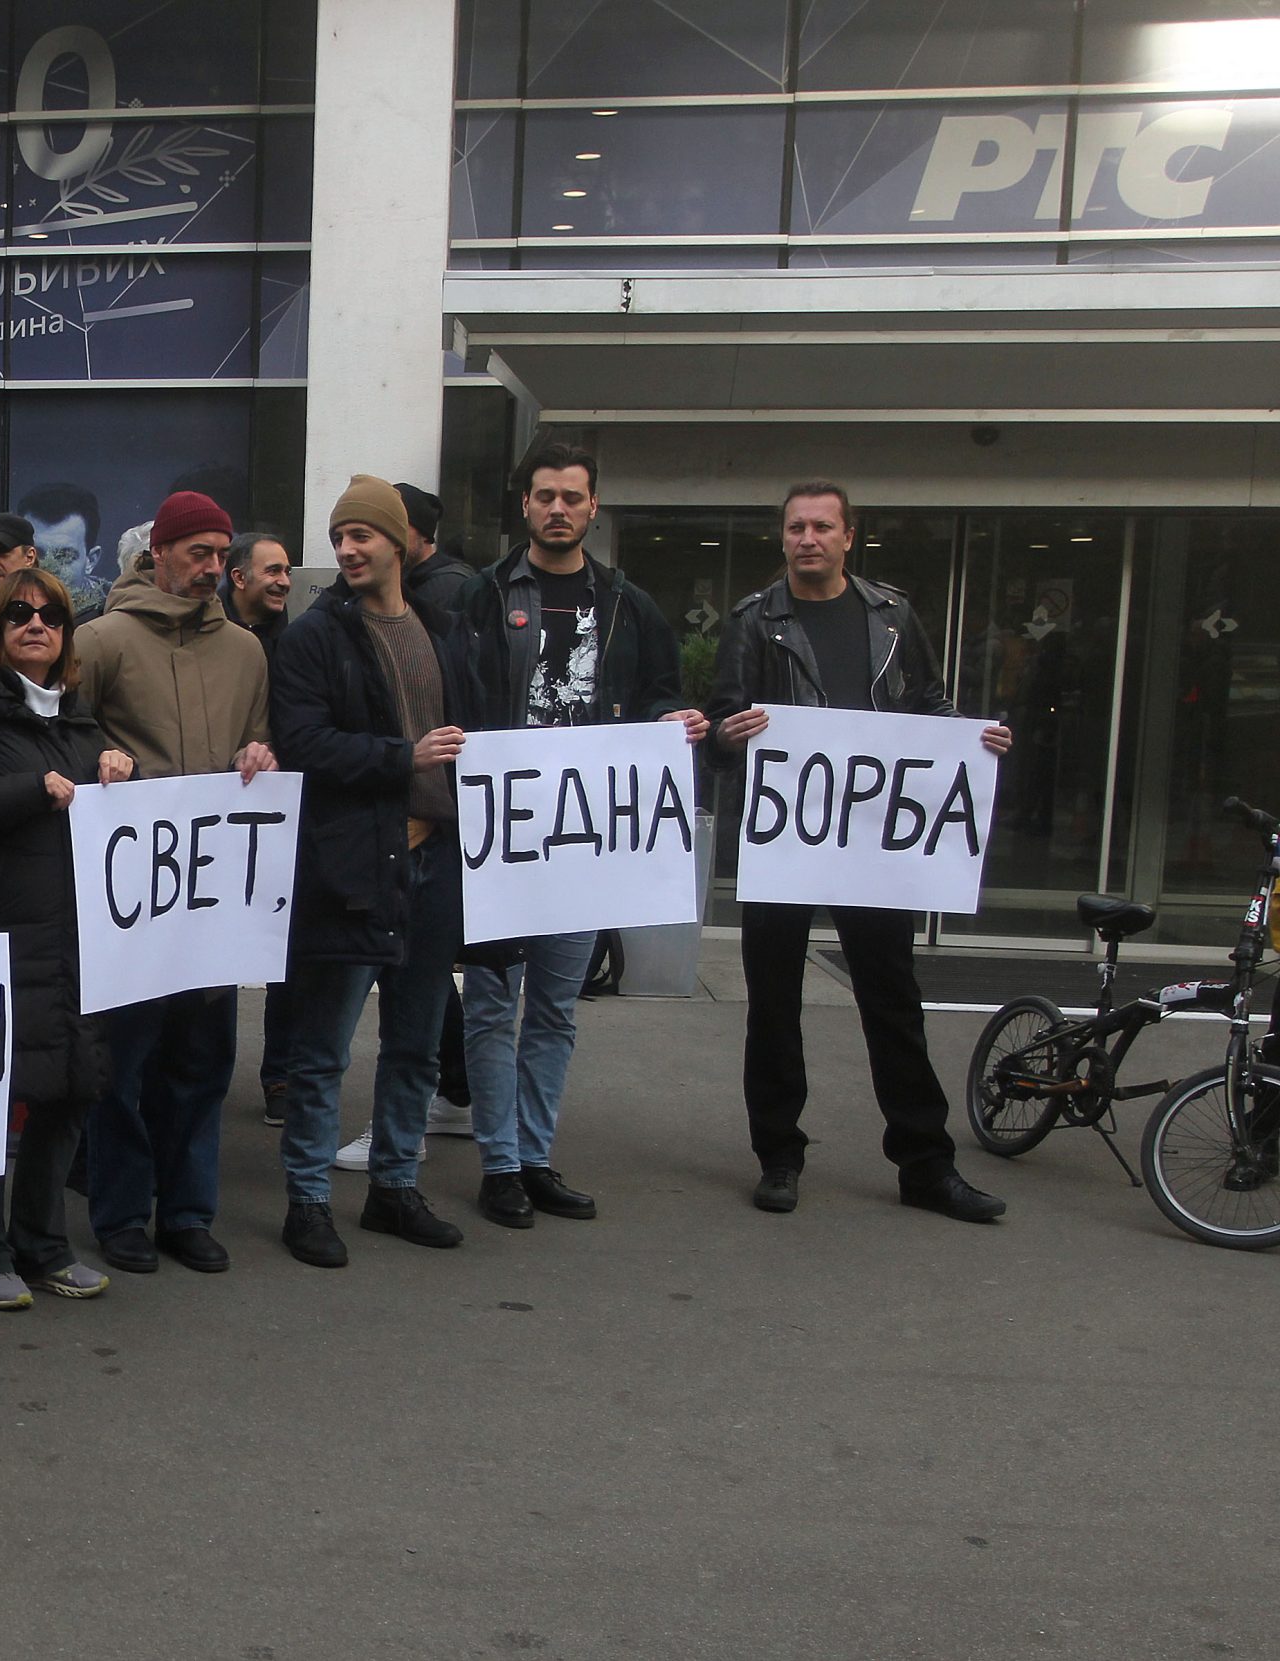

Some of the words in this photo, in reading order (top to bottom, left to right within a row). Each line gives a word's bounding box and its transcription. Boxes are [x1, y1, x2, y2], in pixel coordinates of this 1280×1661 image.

[908, 108, 1234, 222] РТС
[460, 764, 692, 870] ЈЕДНА
[745, 747, 980, 857] БОРБА
[105, 810, 288, 930] СВЕТ,
